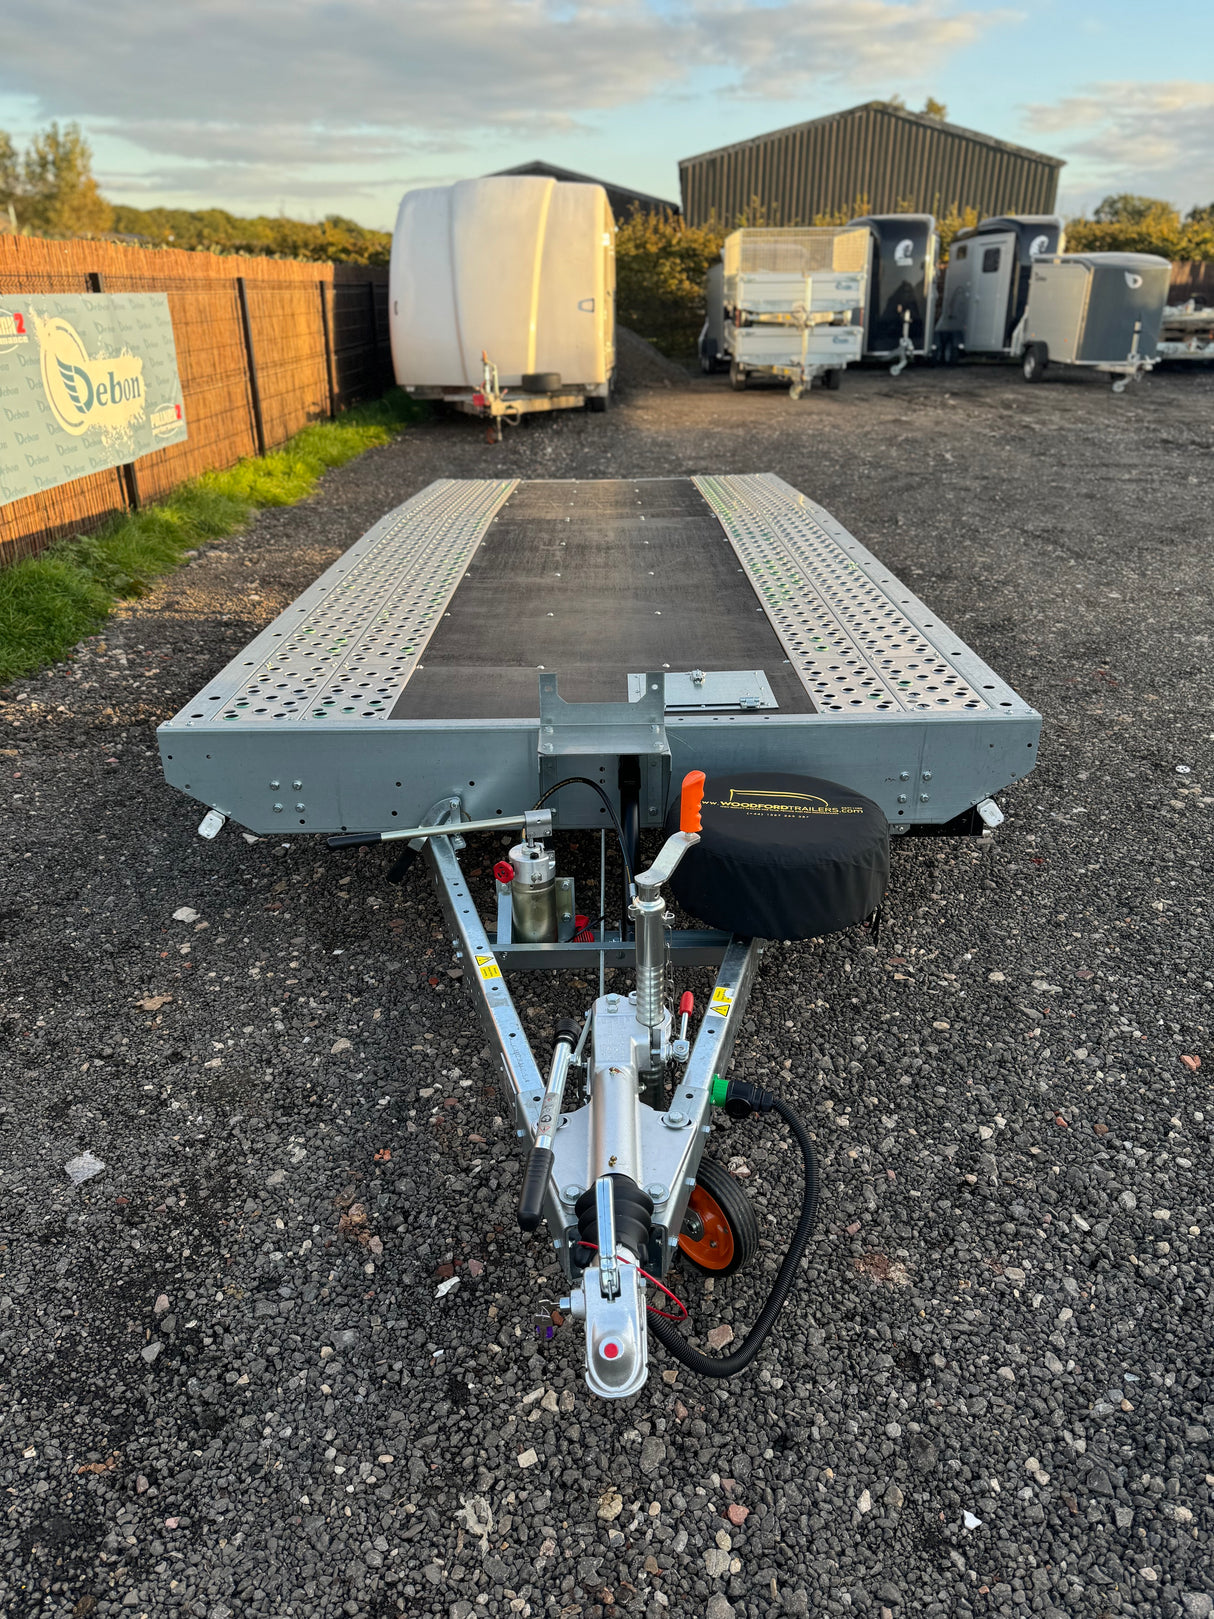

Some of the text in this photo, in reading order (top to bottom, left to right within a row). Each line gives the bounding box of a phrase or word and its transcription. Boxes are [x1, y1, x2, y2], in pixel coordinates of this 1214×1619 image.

[13, 312, 27, 334] 2
[56, 355, 141, 414] Debon
[702, 800, 864, 814] ww.WOODFORDTRAILERS.com
